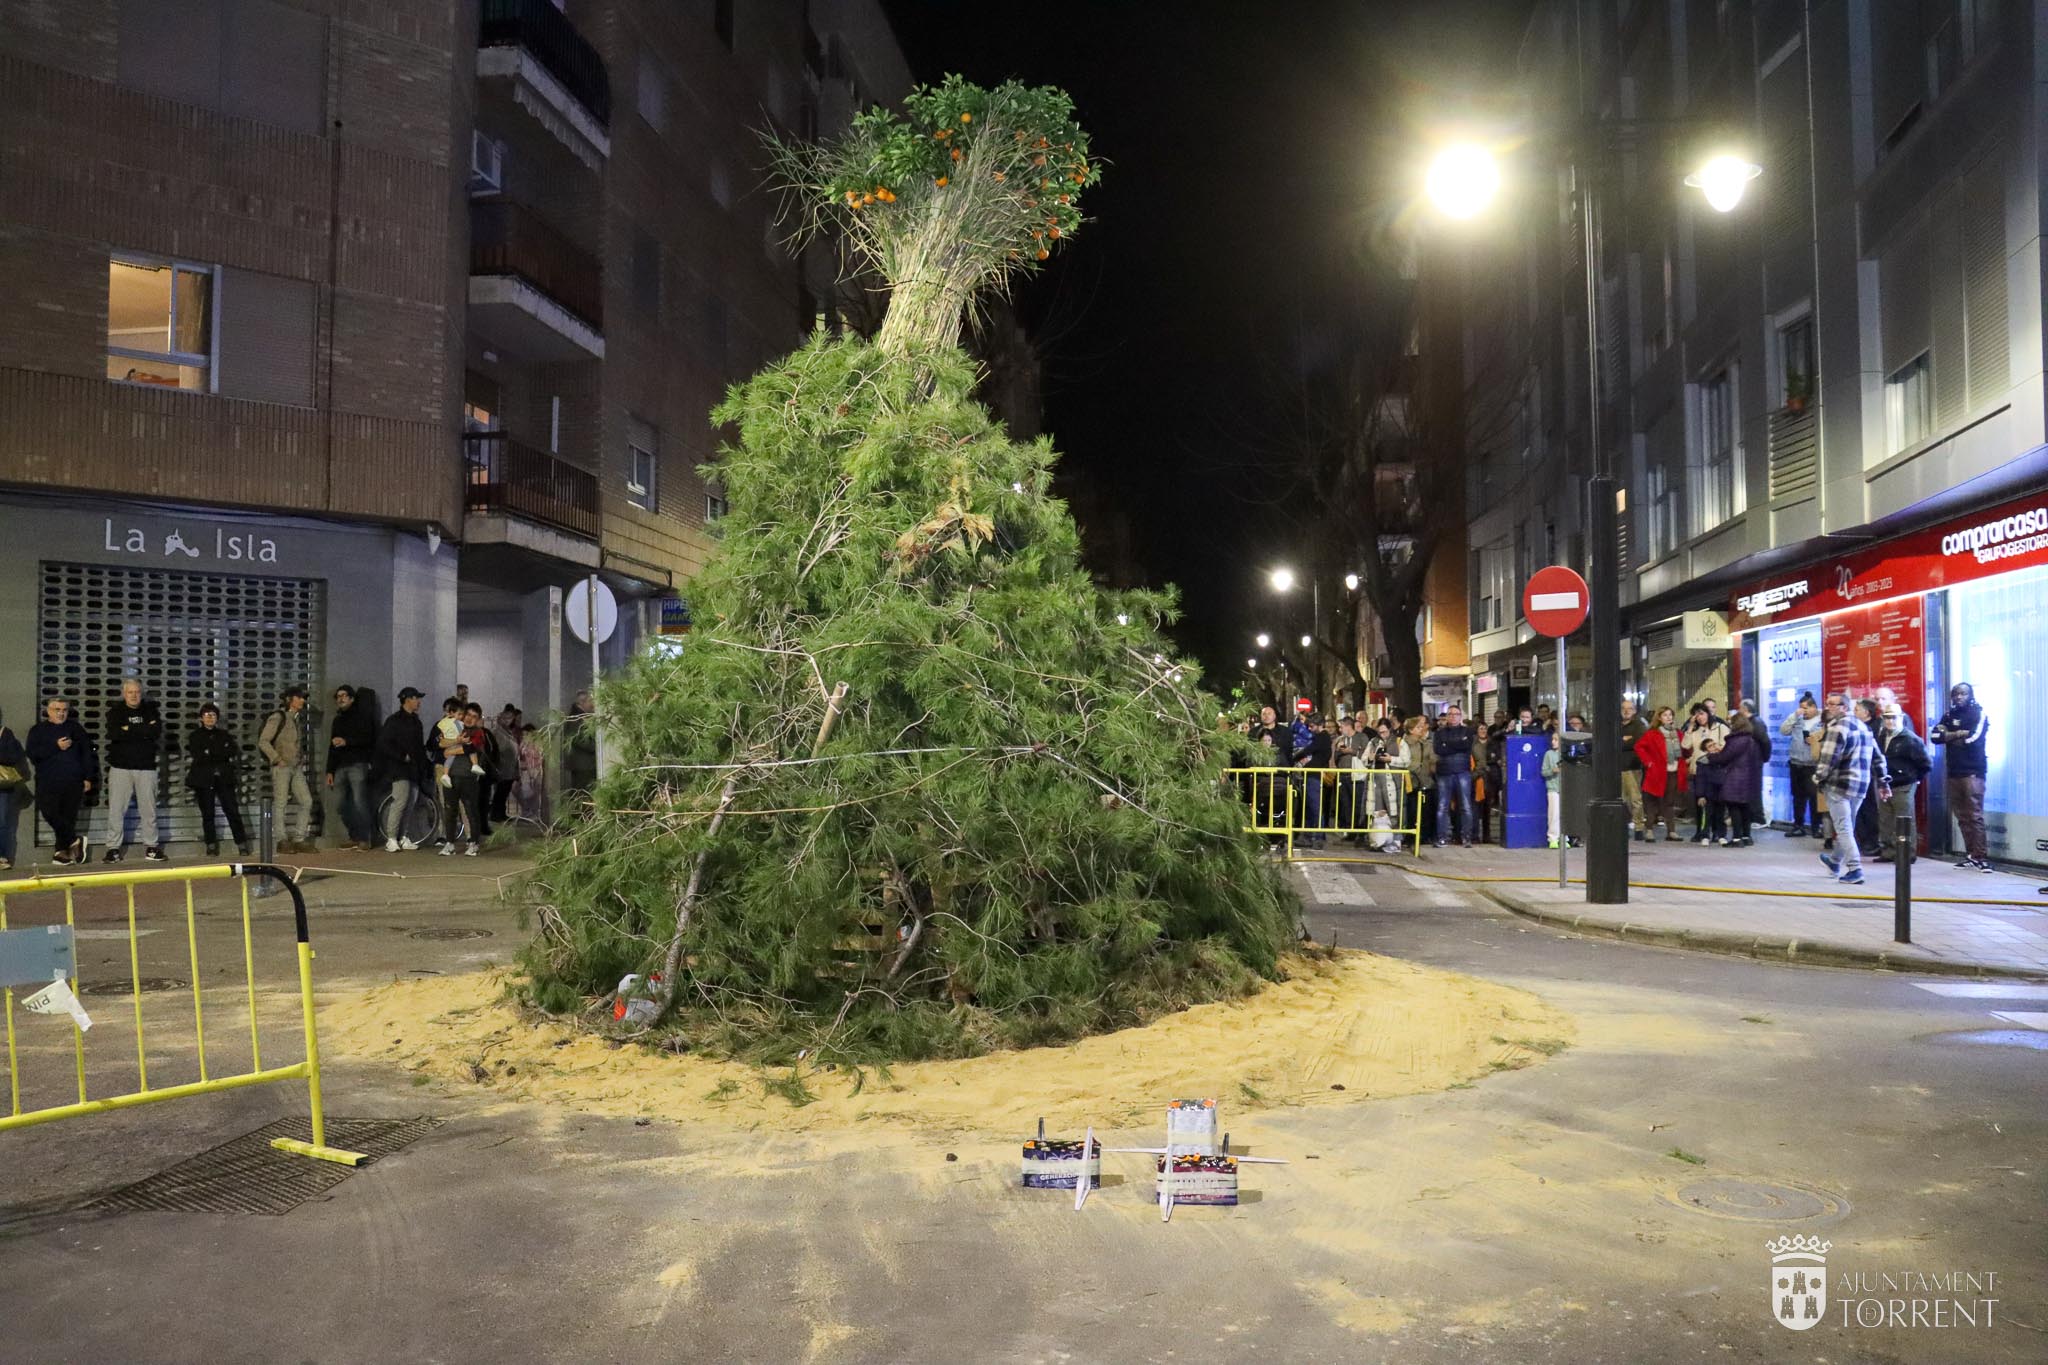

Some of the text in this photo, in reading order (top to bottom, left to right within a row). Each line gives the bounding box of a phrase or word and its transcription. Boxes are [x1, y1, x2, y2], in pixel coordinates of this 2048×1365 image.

[105, 518, 277, 562] La Isla
[1942, 508, 2048, 557] comprarcasa
